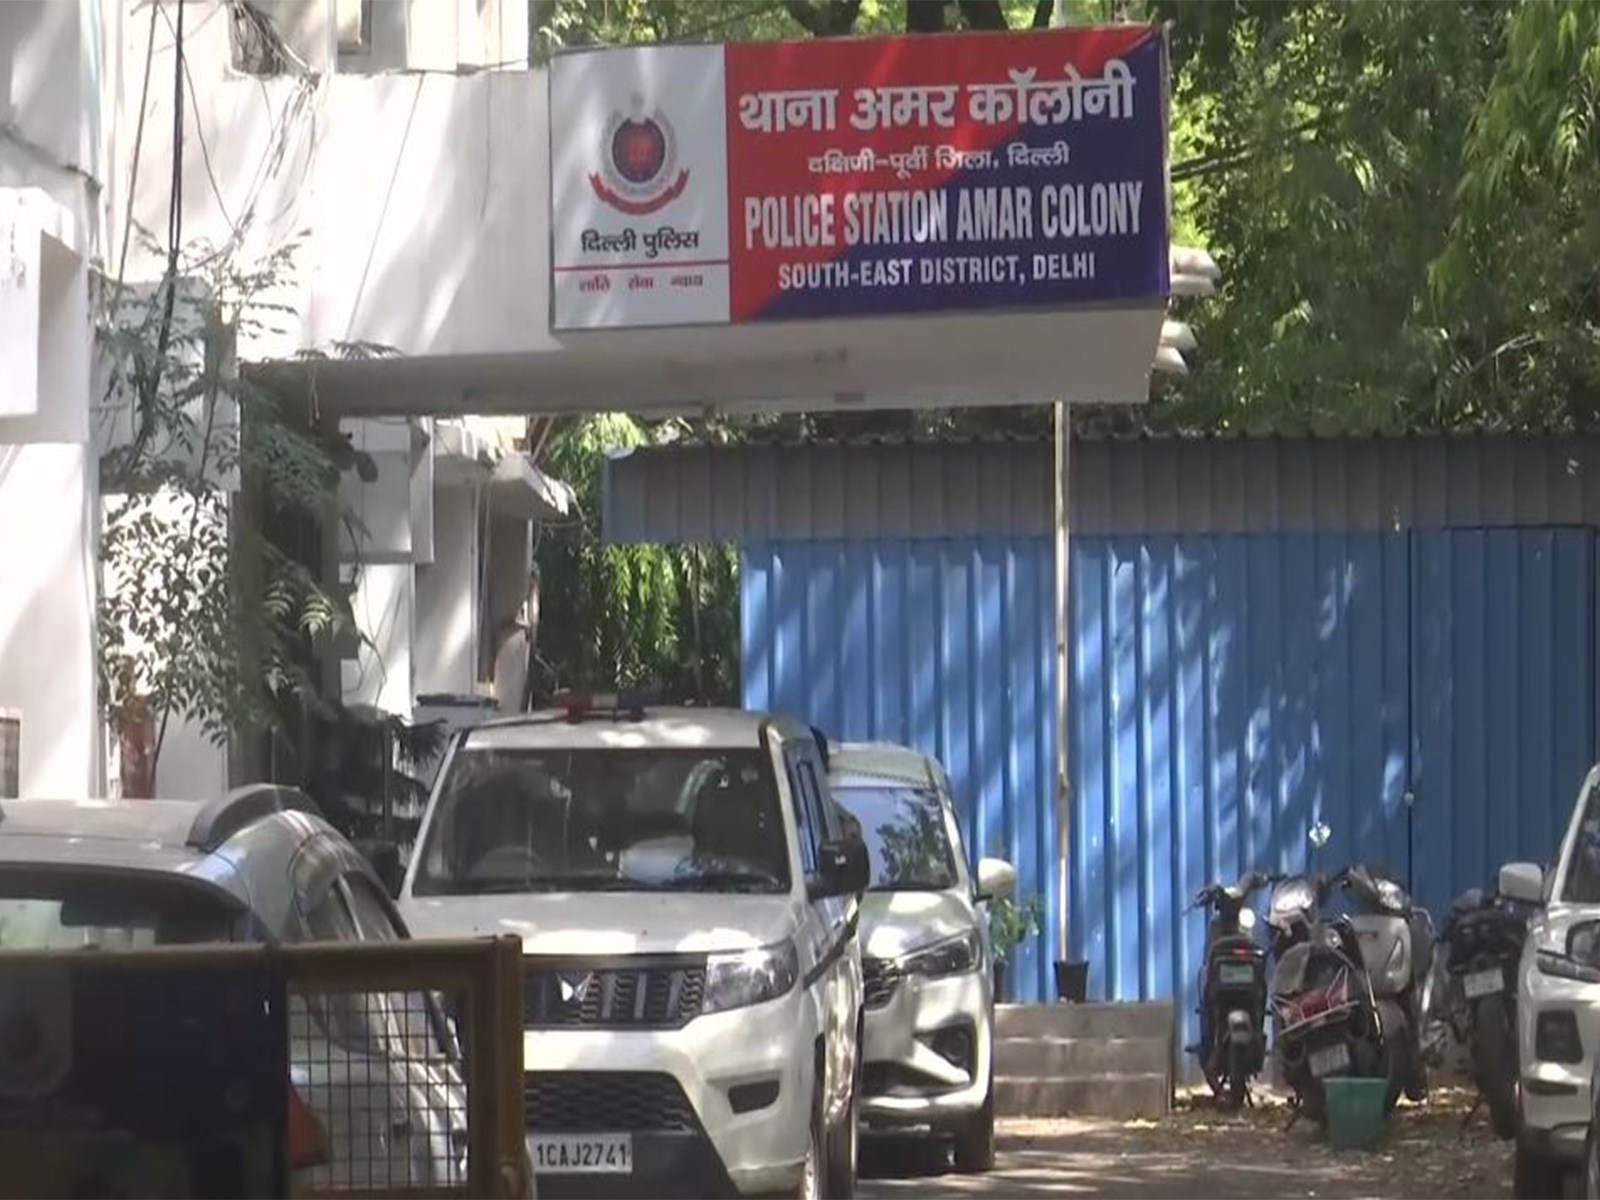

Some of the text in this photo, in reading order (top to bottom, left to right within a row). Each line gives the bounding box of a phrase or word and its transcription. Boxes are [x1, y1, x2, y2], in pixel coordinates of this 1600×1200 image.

[739, 59, 1136, 132] थाना अमर कॉलोनी
[1007, 141, 1070, 167] दिल्ली
[744, 181, 1142, 250] POLICE STATION AMAR COLONY
[581, 227, 699, 257] दिल्ली पुलिस
[778, 252, 1096, 290] SOUTH-EAST DISTRICT, DELHI
